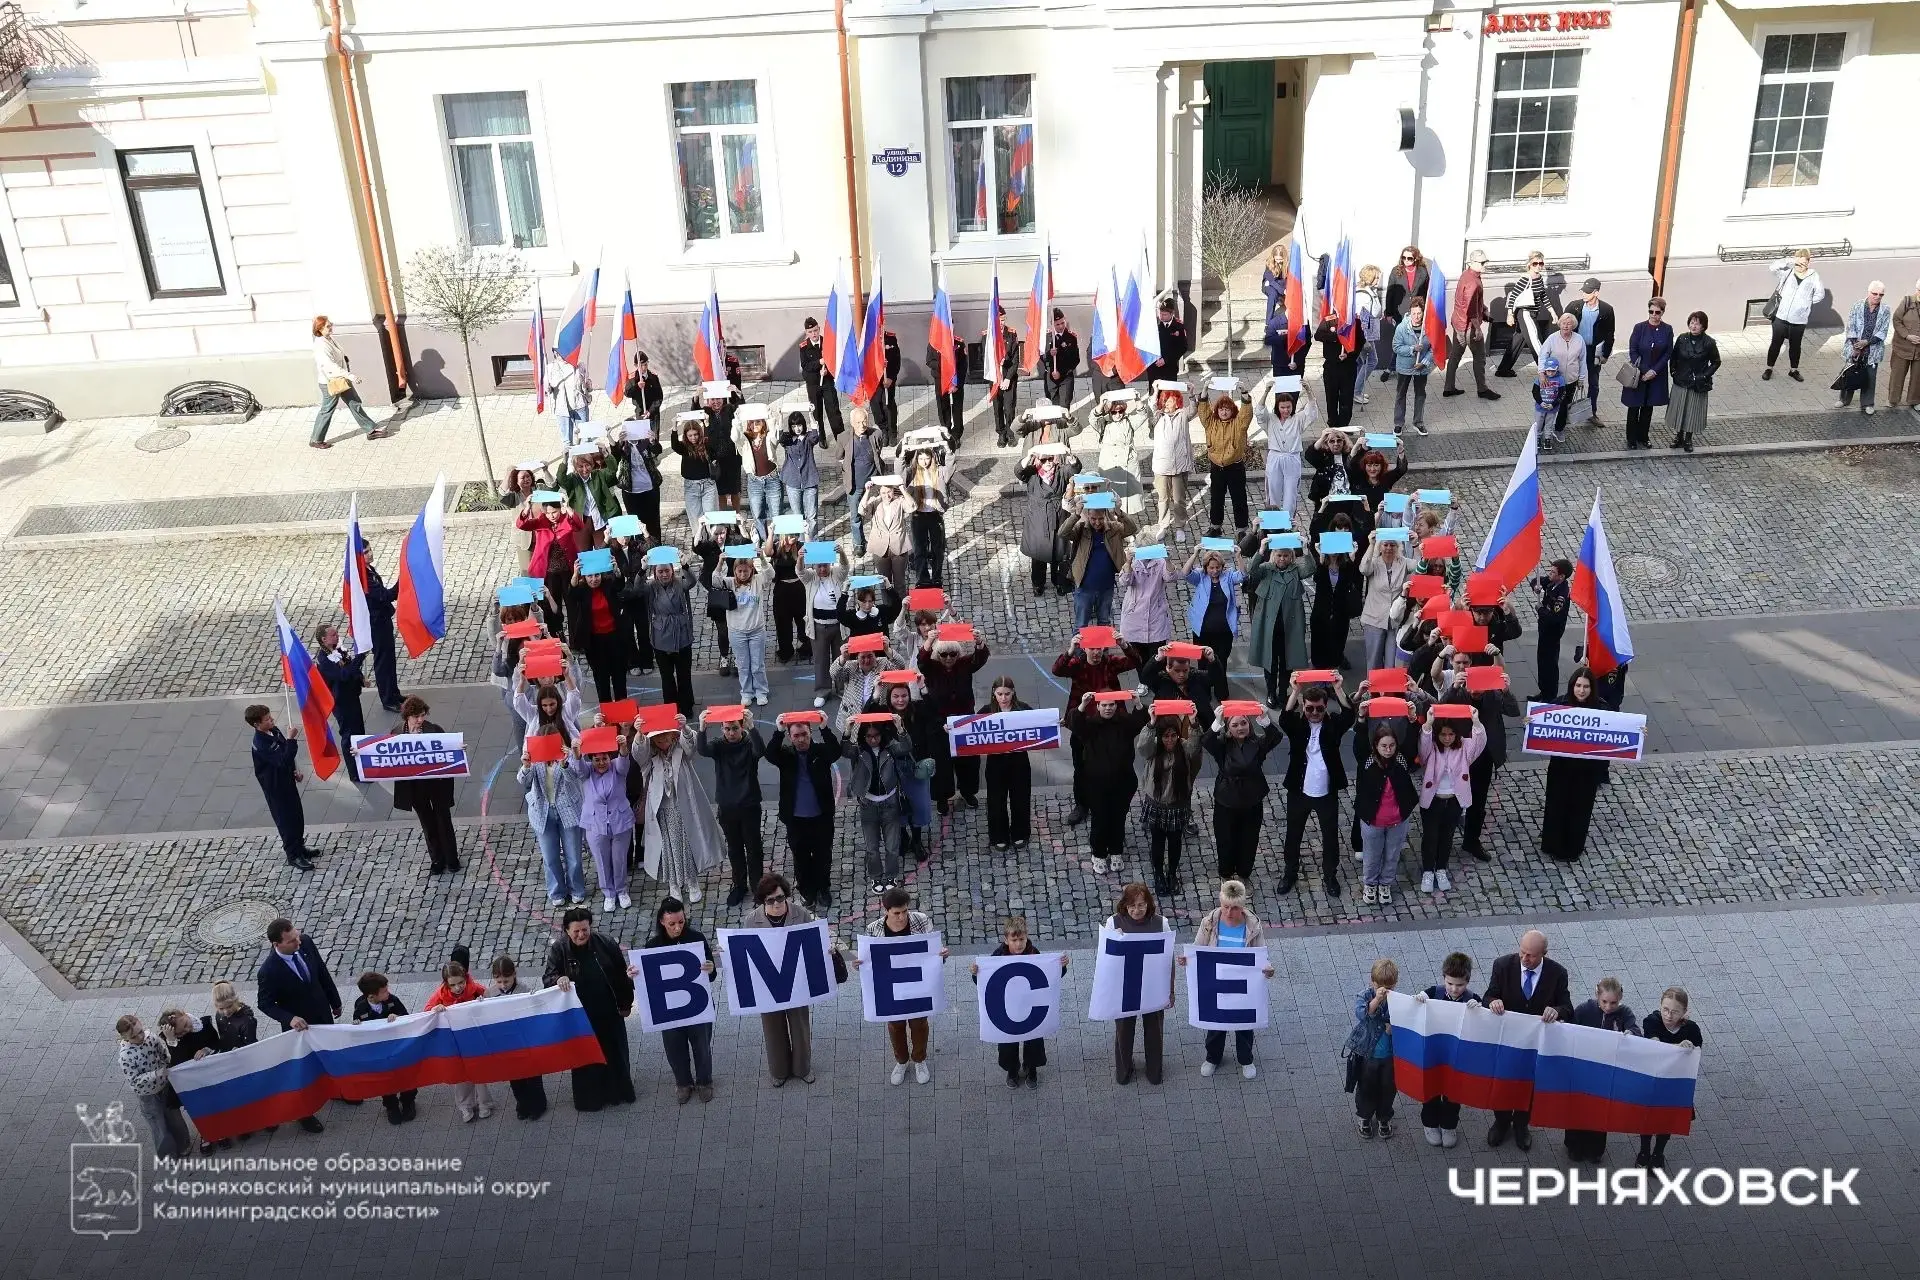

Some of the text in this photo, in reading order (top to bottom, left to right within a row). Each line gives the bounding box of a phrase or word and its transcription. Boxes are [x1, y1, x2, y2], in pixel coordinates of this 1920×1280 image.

[875, 155, 918, 163] Калинина
[891, 163, 903, 173] 12
[971, 719, 1005, 733] МЫ
[1543, 712, 1601, 728] РОССИЯ
[965, 728, 1041, 746] ВМЕСТЕ!
[1532, 726, 1630, 745] ЕДИНАЯ СТРАНА
[375, 740, 444, 755] СИЛА В
[370, 751, 455, 768] ЕДИНСТВЕ
